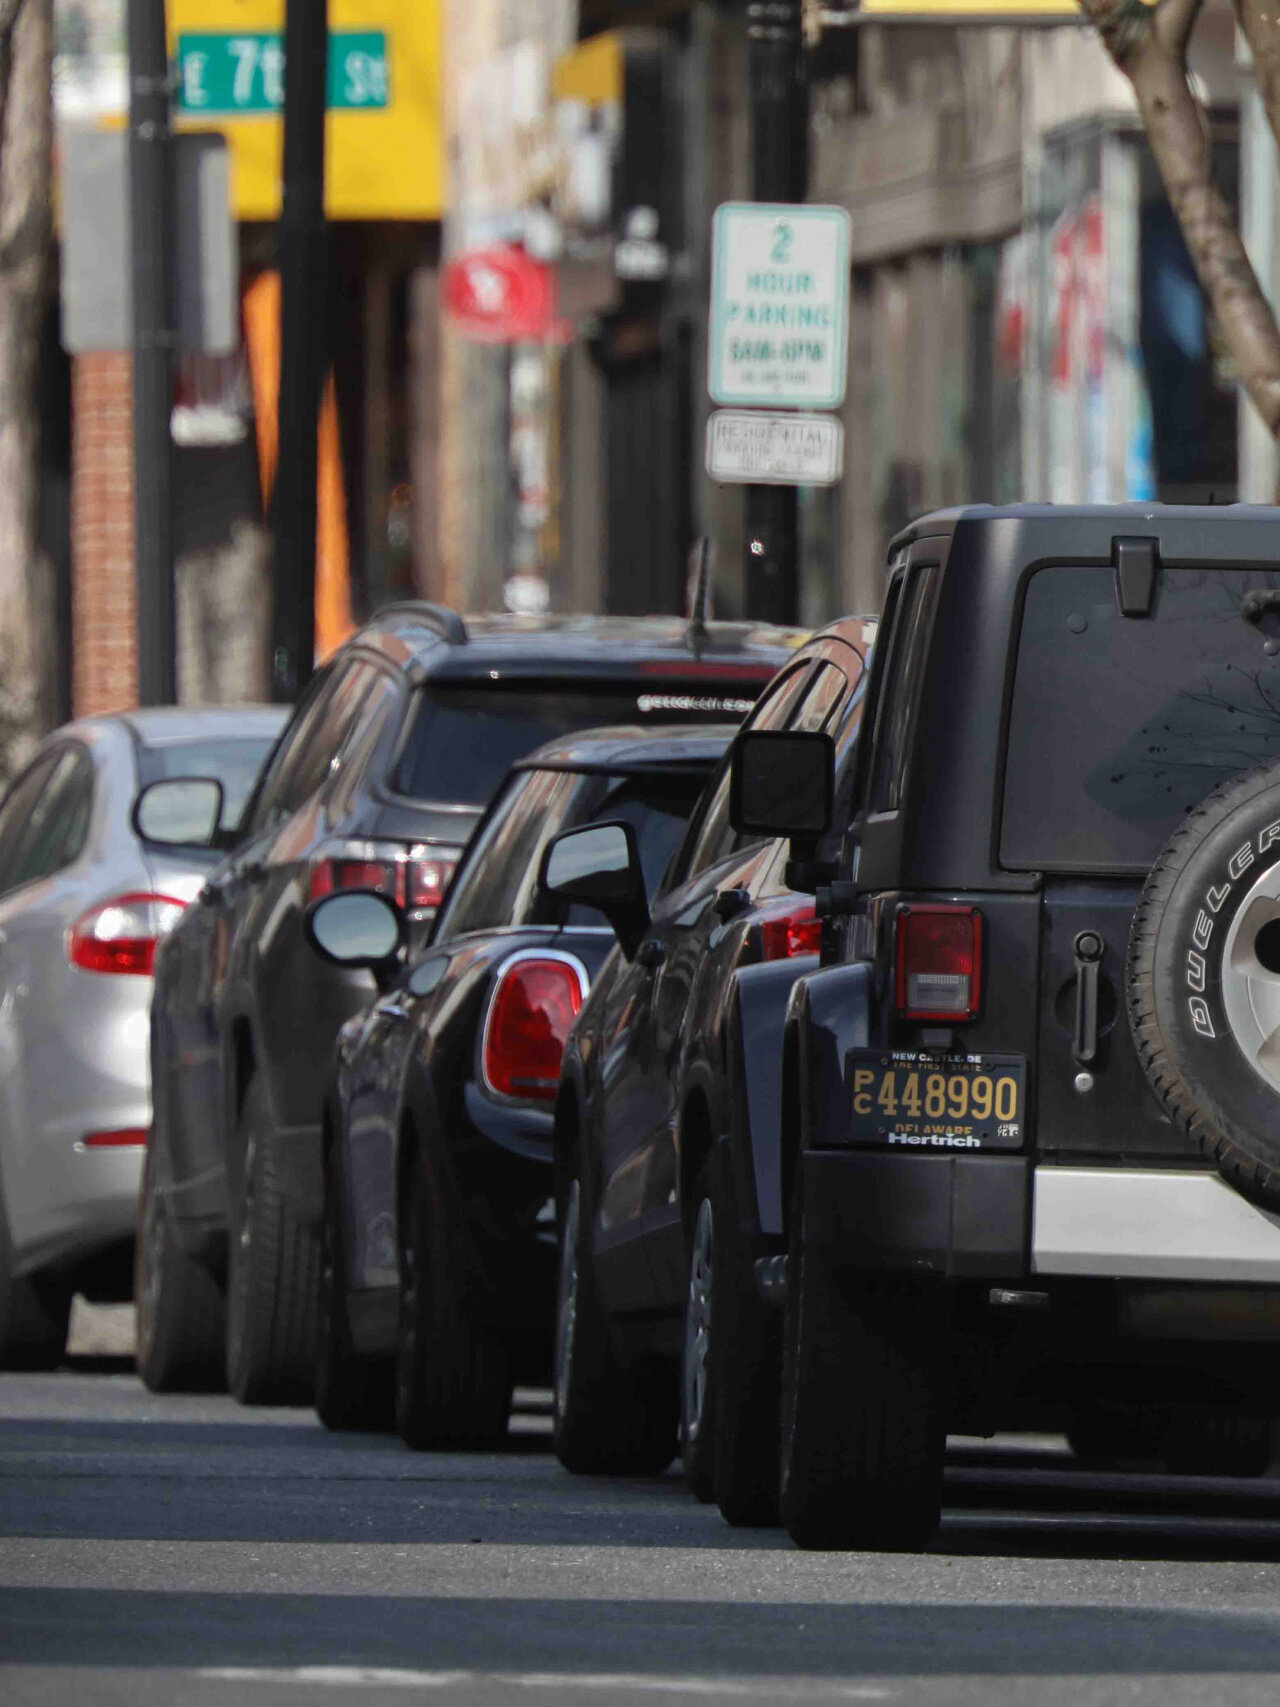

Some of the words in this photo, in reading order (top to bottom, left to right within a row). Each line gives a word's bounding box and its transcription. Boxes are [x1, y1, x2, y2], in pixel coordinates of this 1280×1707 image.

[184, 51, 208, 106] E
[344, 50, 389, 104] St
[770, 224, 795, 262] 2
[747, 272, 814, 293] HOUR
[727, 303, 831, 327] PARKING
[892, 1053, 917, 1062] NEW
[967, 1055, 982, 1064] DE
[877, 1071, 1018, 1121] 448990
[888, 1132, 981, 1148] Hertrich
